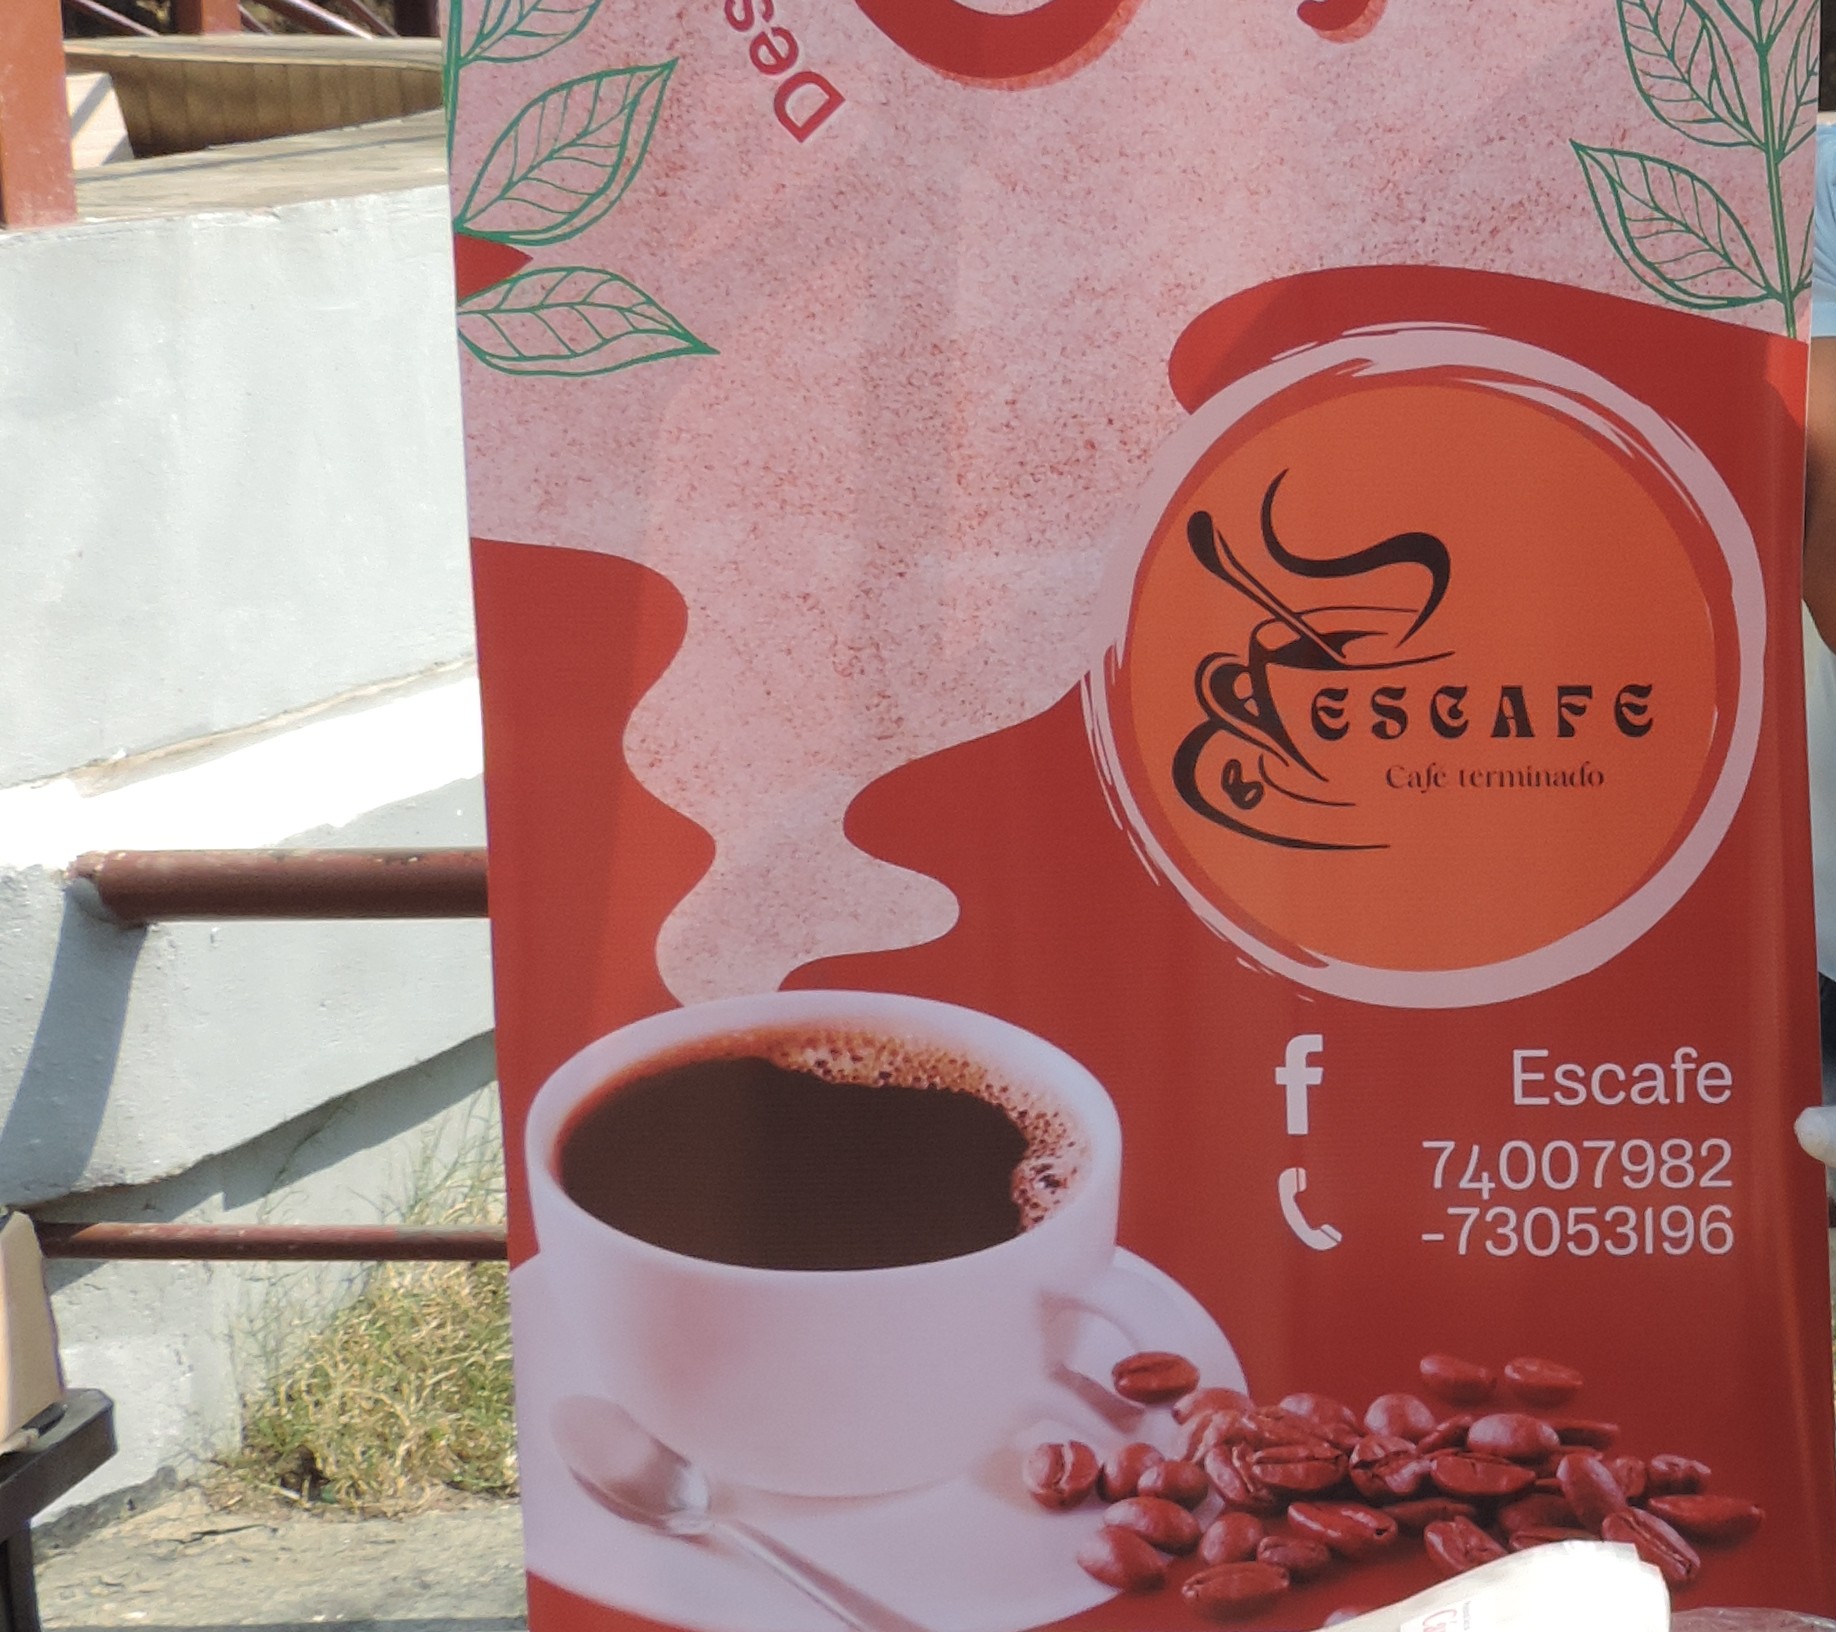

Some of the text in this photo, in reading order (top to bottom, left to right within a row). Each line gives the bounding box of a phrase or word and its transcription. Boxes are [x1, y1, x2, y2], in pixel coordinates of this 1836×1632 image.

[1309, 683, 1655, 742] ESCAFE
[1458, 760, 1605, 789] terminado
[1512, 1045, 1734, 1107] Escafe
[1421, 1137, 1734, 1200] 74007982
[1420, 1203, 1735, 1257] -73053196
